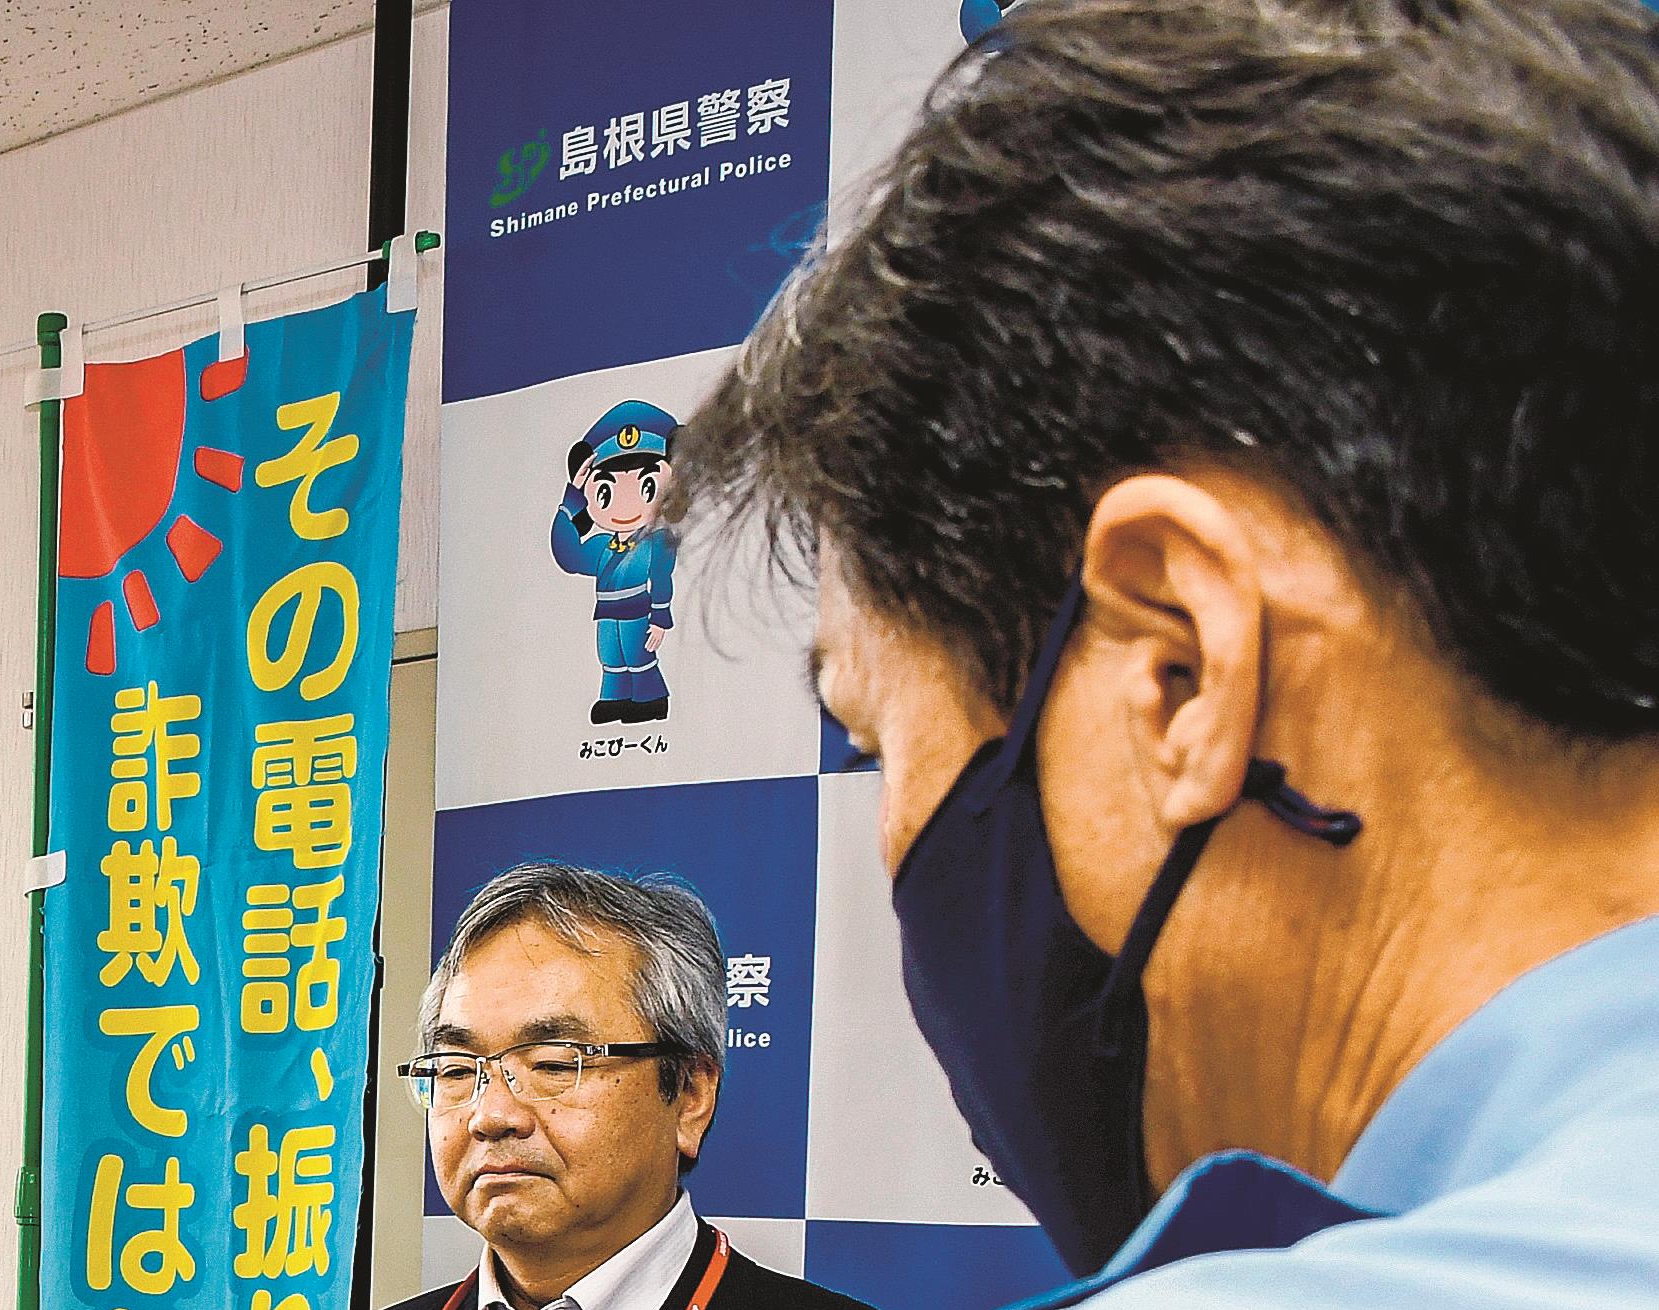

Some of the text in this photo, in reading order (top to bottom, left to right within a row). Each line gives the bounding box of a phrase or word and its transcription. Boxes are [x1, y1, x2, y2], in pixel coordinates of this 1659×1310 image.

[559, 77, 791, 180] 島根県警察
[490, 152, 792, 238] Shimane Prefectural Police
[727, 1028, 772, 1048] lice
